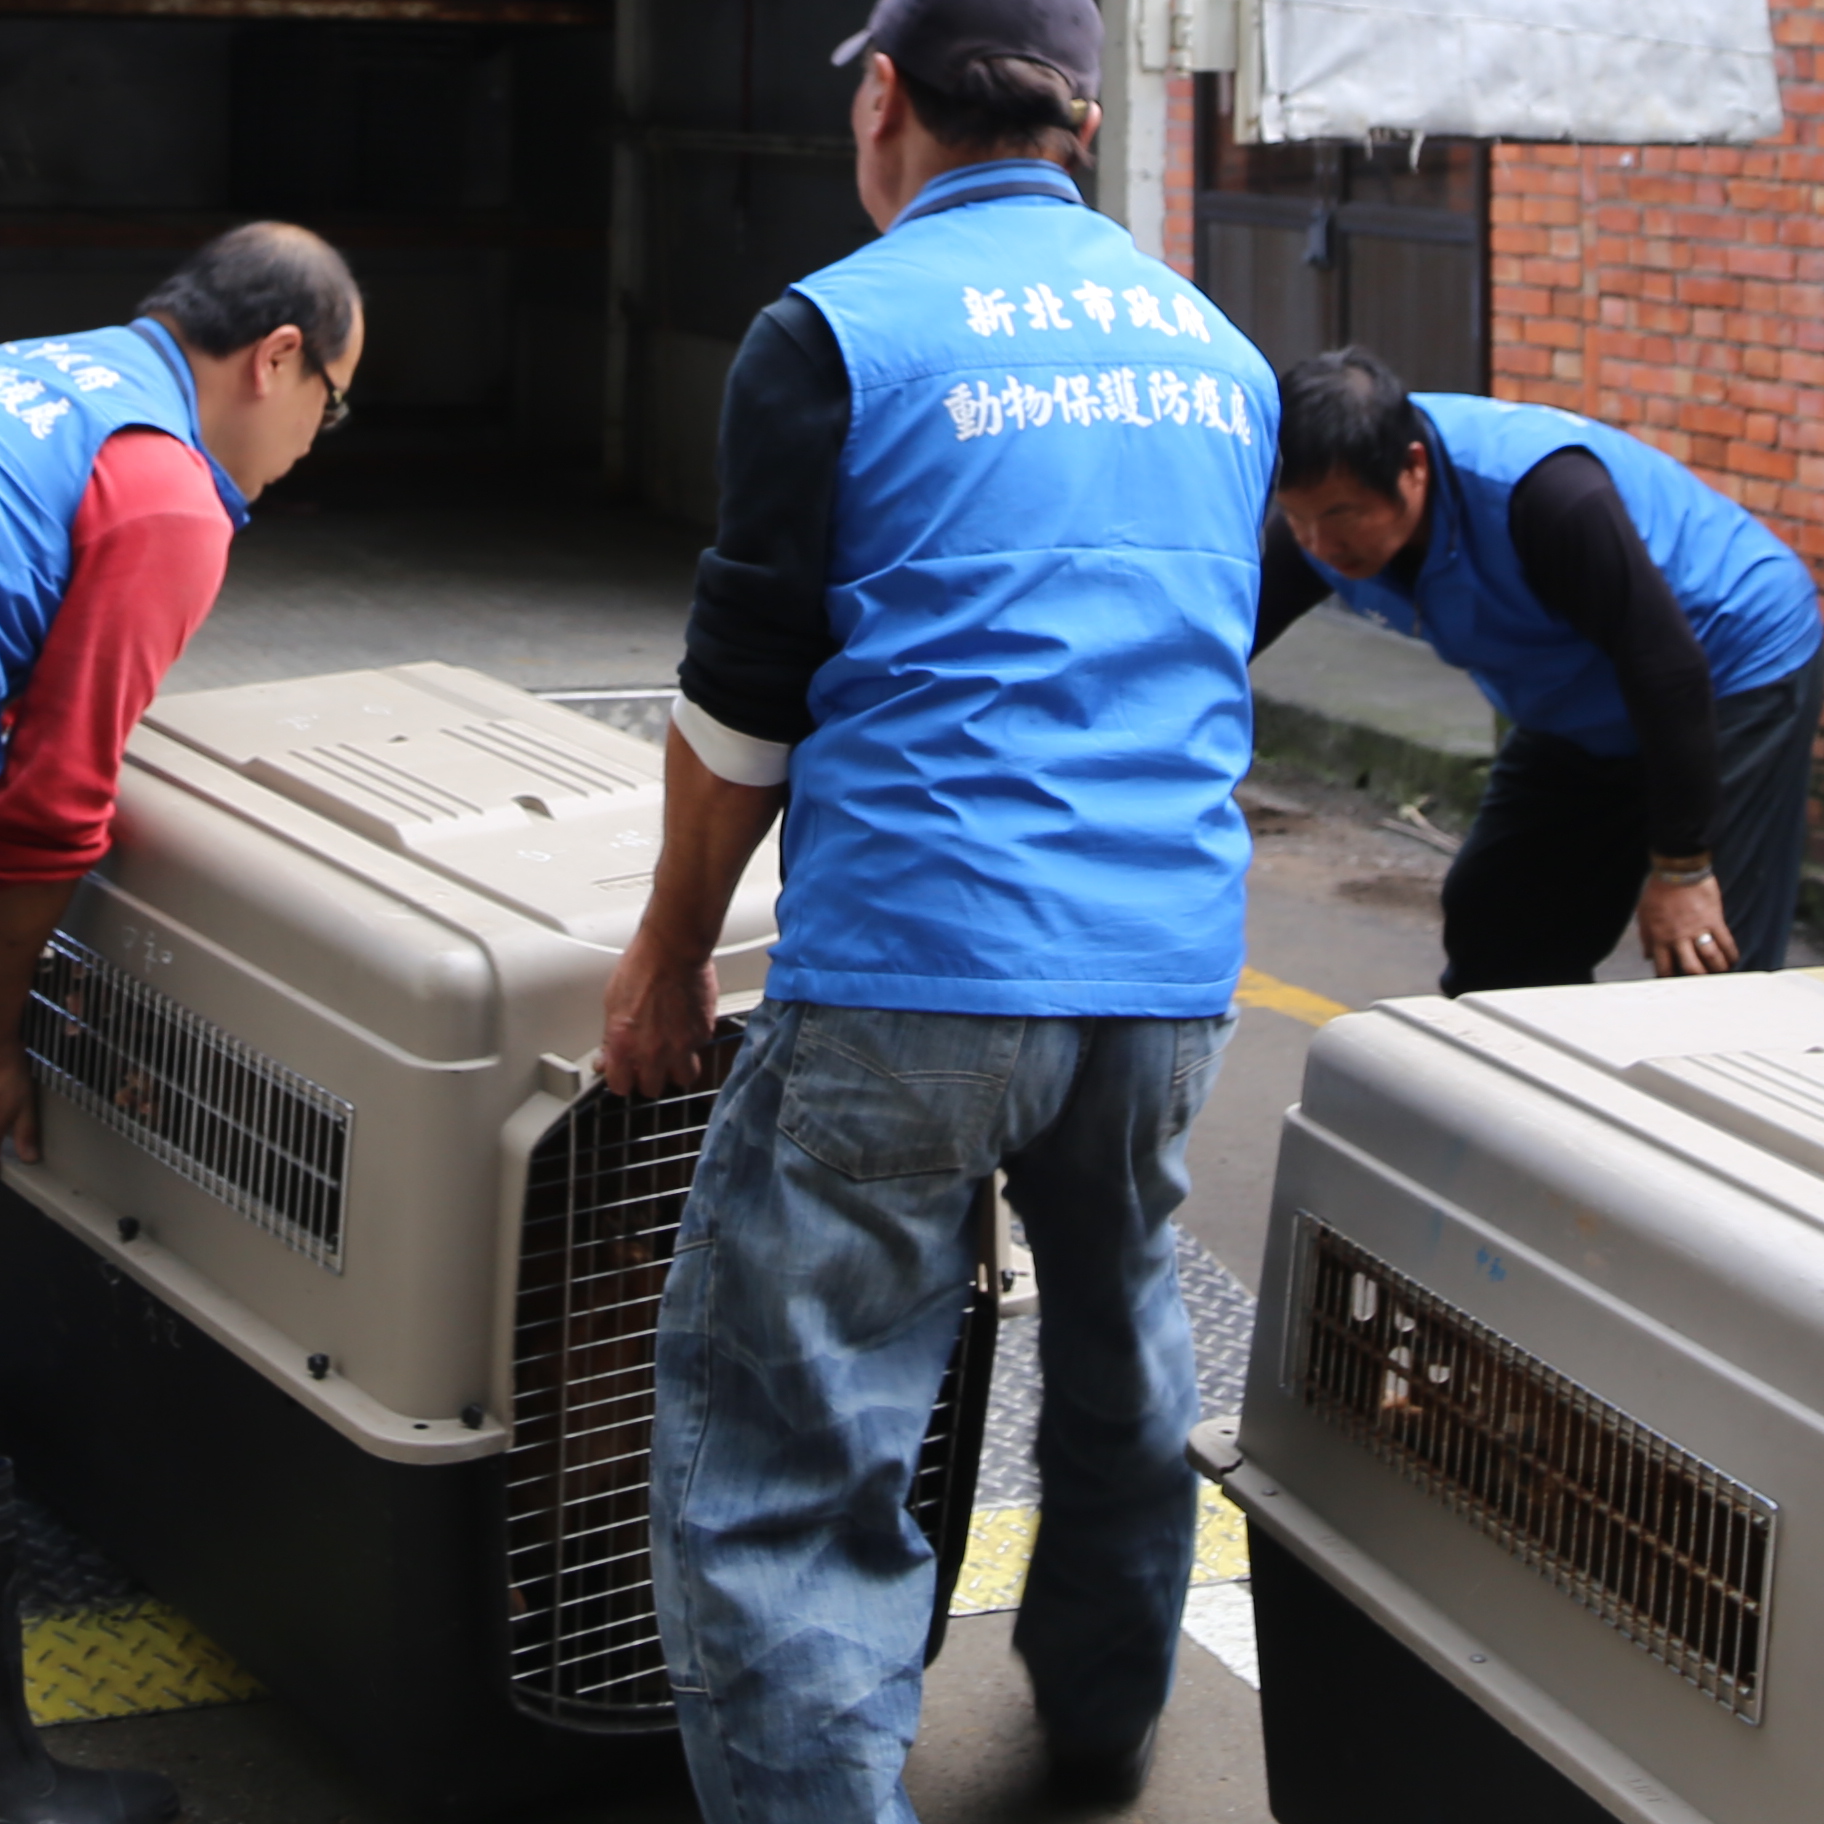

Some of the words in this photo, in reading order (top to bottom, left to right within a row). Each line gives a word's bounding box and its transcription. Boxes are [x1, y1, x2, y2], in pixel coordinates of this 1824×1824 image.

[962, 279, 1211, 344] 新北市政府
[943, 366, 1252, 446] 動物保護防疫處
